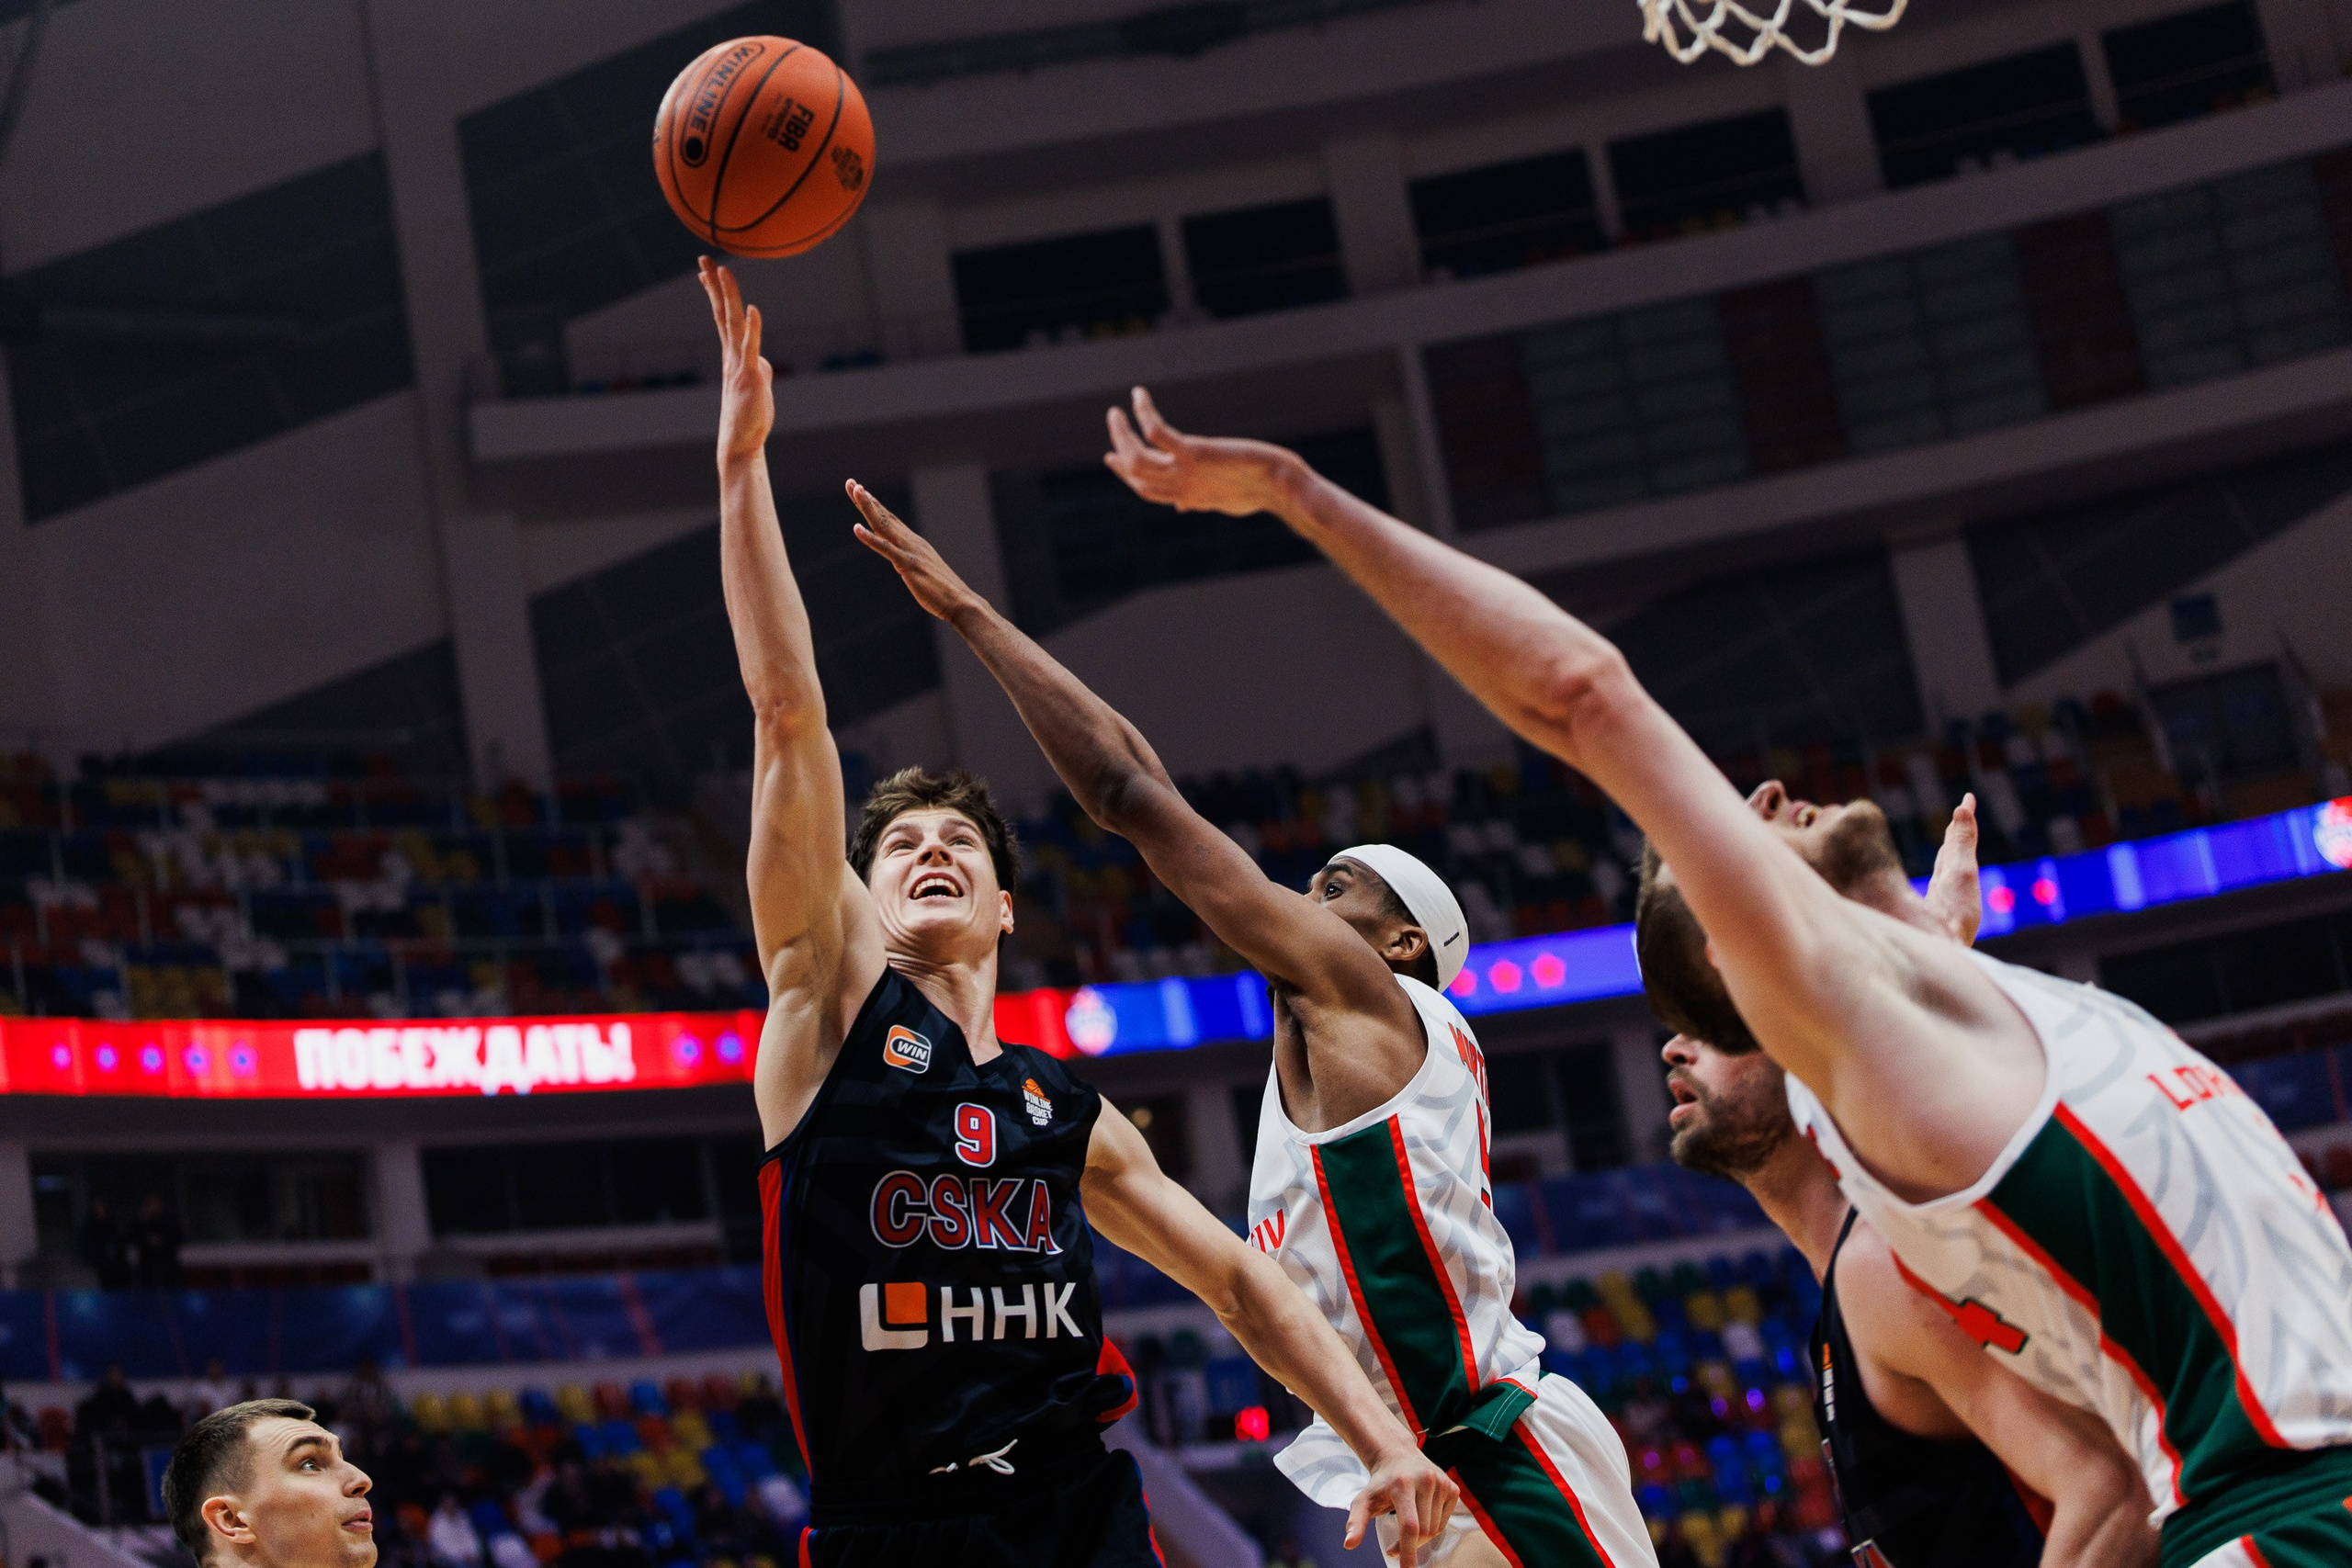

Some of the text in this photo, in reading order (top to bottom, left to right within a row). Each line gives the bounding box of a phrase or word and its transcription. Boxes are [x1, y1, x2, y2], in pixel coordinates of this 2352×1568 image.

[691, 47, 753, 133] WINLINE
[777, 103, 815, 152] FIBA
[897, 1041, 928, 1060] WIN
[954, 1102, 996, 1168] 9
[1032, 1116, 1049, 1126] CUP
[870, 1170, 1063, 1255] CSKA
